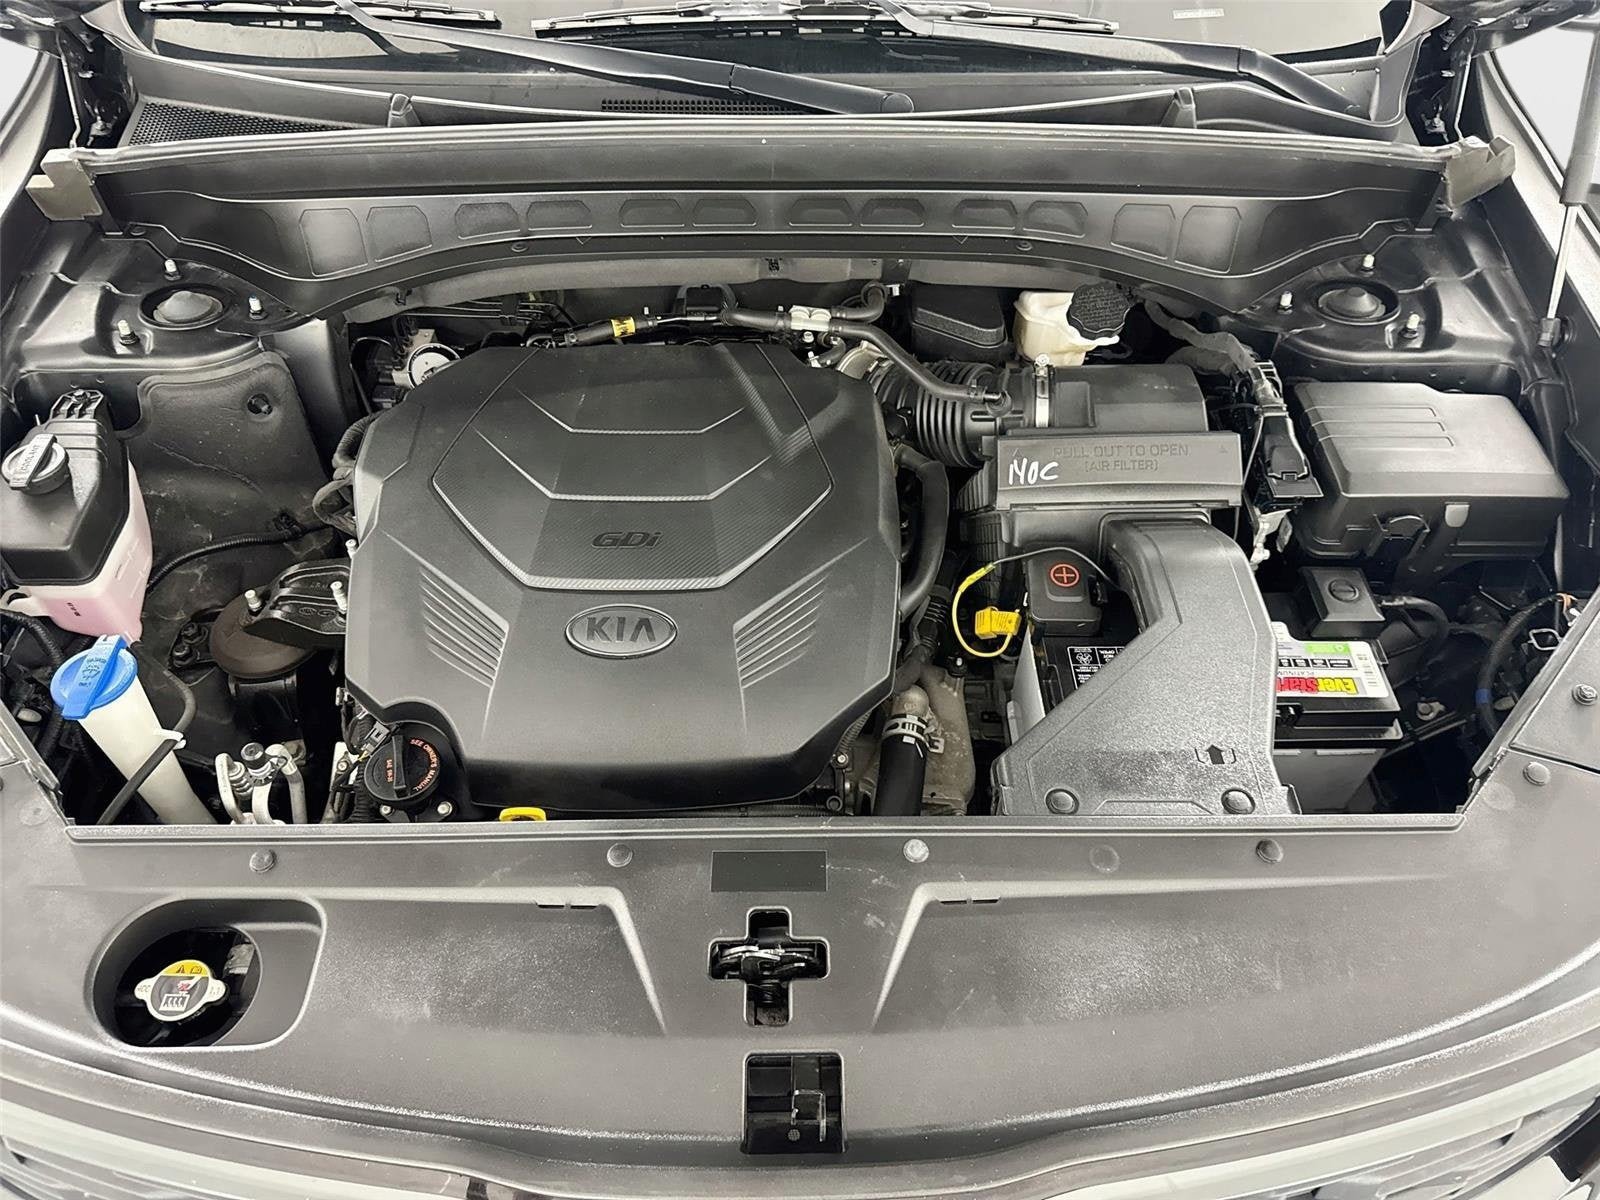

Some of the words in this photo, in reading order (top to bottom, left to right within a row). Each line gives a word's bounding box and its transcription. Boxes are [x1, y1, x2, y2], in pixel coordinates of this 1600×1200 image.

[1053, 446, 1090, 458] PULL
[1093, 444, 1124, 457] OUT
[1126, 444, 1146, 457] TO
[1149, 443, 1189, 457] OPEN
[1113, 458, 1159, 472] FILTER)
[586, 616, 656, 642] KIA
[410, 739, 425, 747] SEE
[413, 769, 436, 791] MANUAL
